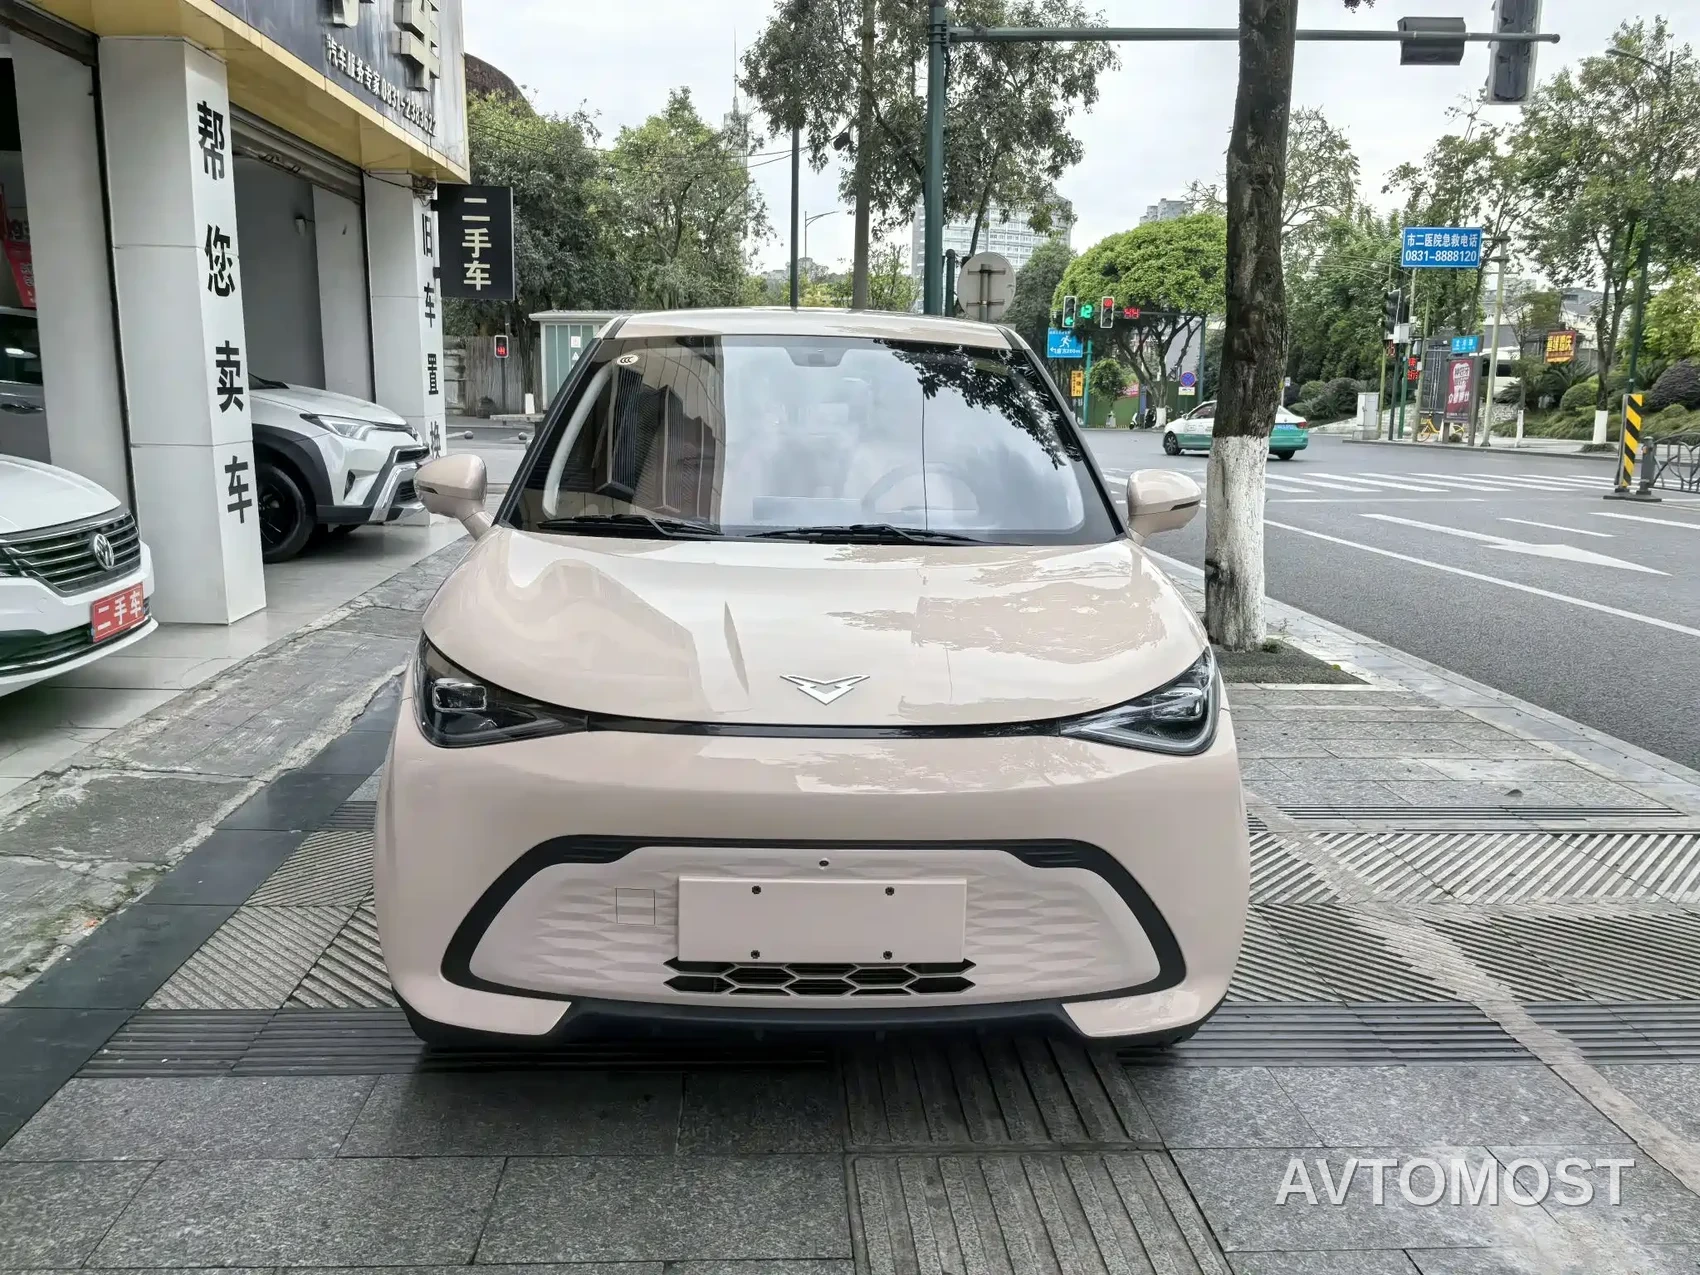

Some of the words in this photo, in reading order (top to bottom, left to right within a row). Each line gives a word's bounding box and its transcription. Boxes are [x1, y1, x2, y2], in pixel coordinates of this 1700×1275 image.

[461, 197, 492, 291] 二手车
[1405, 250, 1477, 262] 0831-8888120
[1406, 233, 1478, 247] 市二医院急救电话
[197, 100, 253, 524] 帮您卖车
[421, 212, 442, 459] 旧车置换
[97, 590, 142, 631] 二手车
